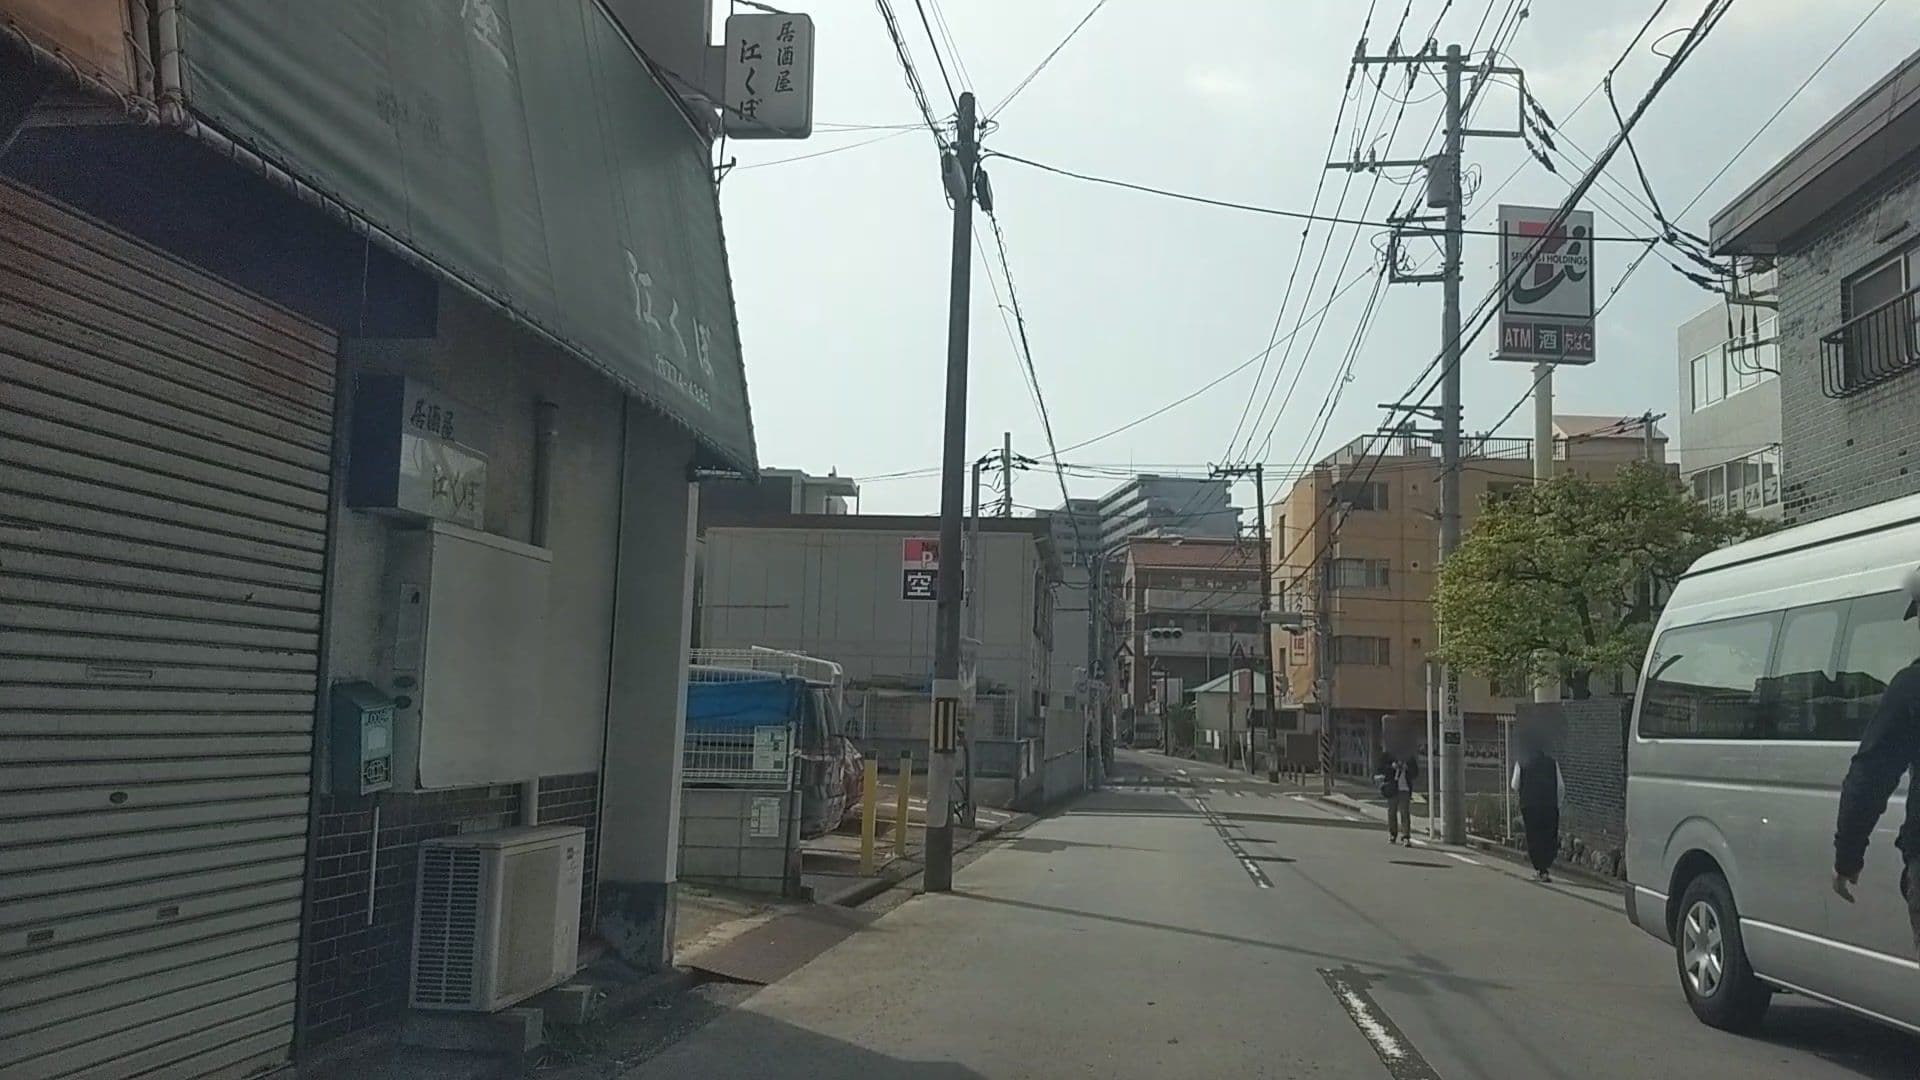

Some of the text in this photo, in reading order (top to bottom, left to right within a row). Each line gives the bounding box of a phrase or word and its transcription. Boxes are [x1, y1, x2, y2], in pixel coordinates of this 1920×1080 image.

[774, 20, 795, 93] 居酒屋
[739, 38, 763, 121] 江くぼ
[1546, 254, 1588, 265] HOLDINGS
[1504, 327, 1531, 349] ATM
[1539, 329, 1557, 349] 酒
[1565, 332, 1592, 352] たばこ
